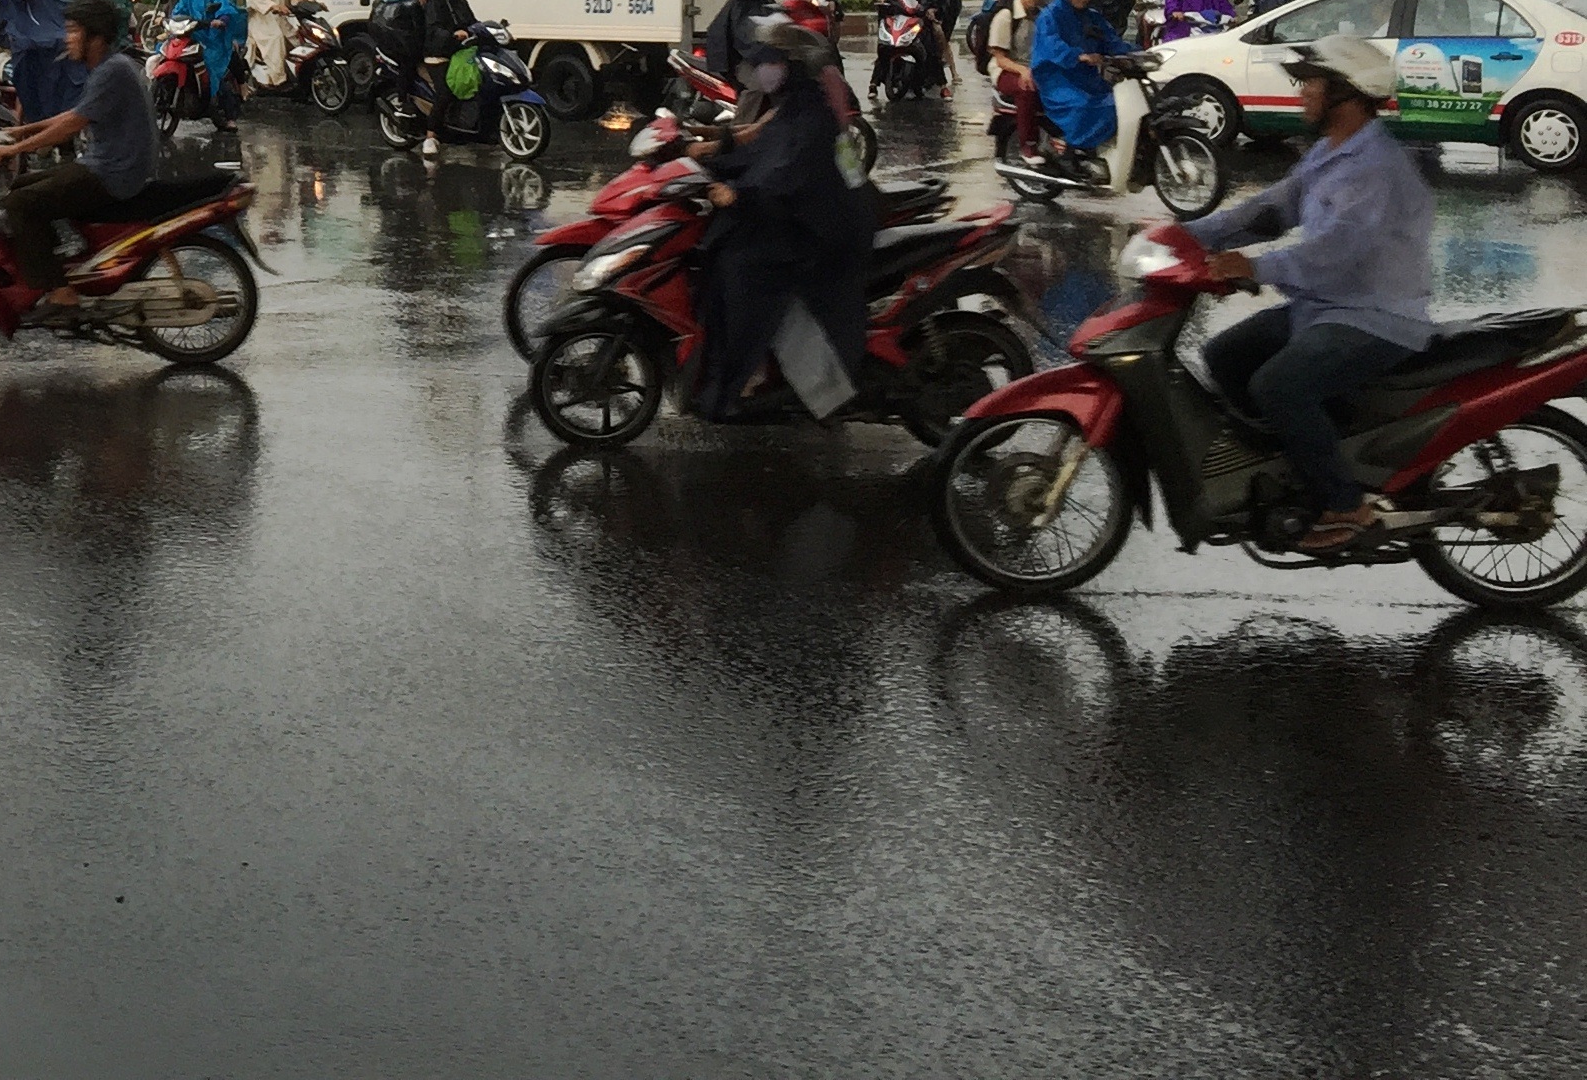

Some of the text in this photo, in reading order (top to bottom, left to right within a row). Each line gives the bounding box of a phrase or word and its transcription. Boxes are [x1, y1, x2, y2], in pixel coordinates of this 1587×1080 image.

[1427, 99, 1440, 108] 38
[1440, 101, 1452, 109] 27
[1455, 101, 1466, 110] 27
[1469, 101, 1481, 110] 27
